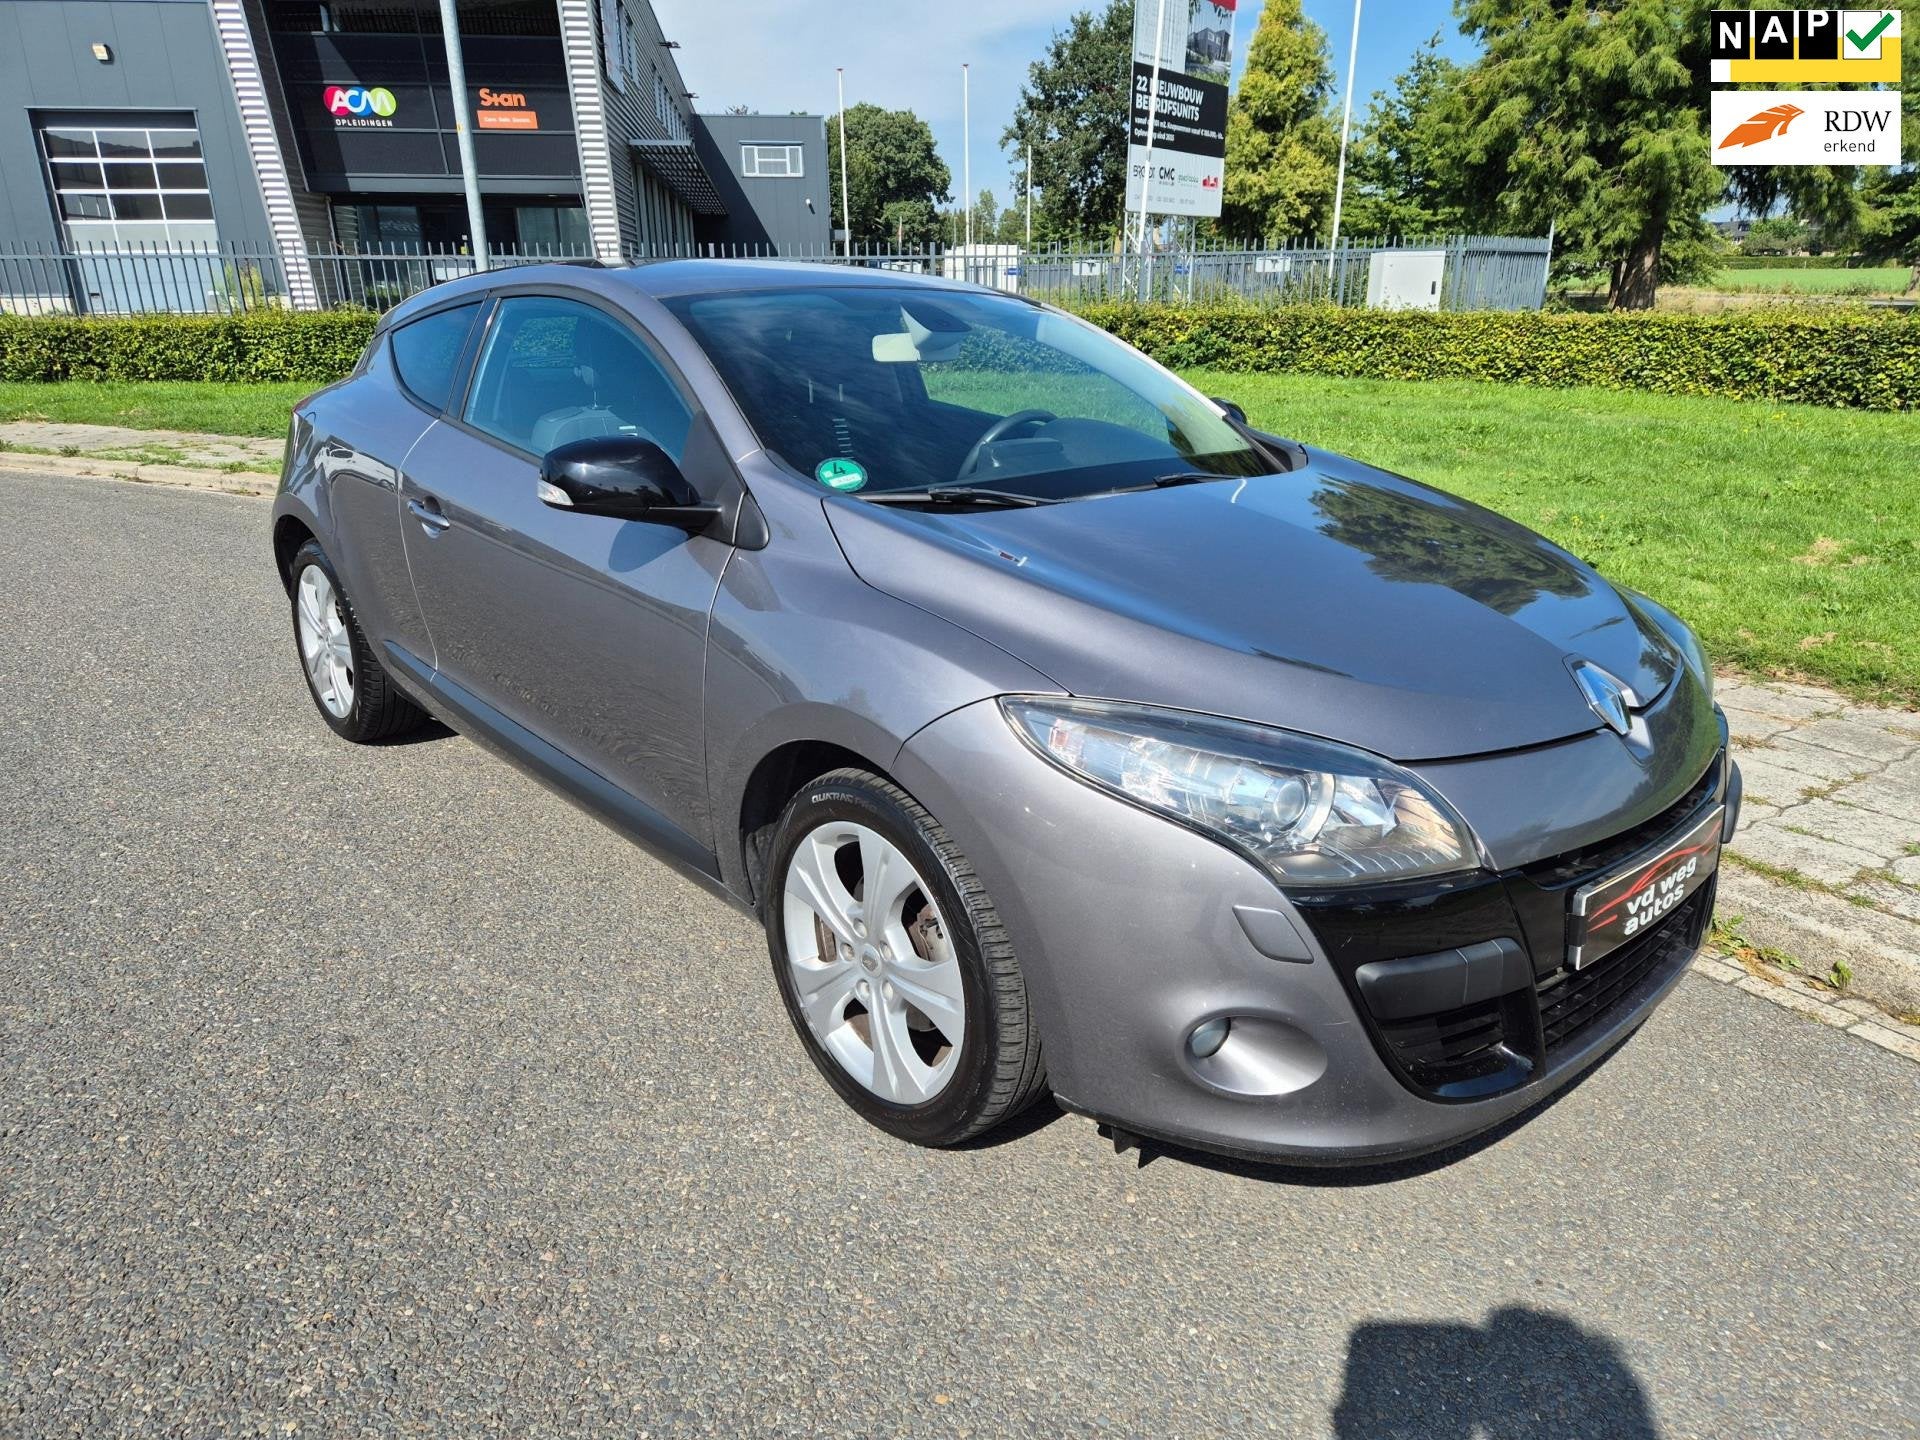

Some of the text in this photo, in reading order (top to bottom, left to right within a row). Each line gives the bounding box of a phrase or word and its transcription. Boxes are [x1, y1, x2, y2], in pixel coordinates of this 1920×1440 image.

[1136, 75, 1148, 92] 22
[330, 89, 394, 113] ACM
[335, 118, 393, 127] OPLEIDINGEN
[1159, 166, 1175, 181] CMC
[1626, 857, 1697, 915] vd weg
[1623, 884, 1685, 935] autos
